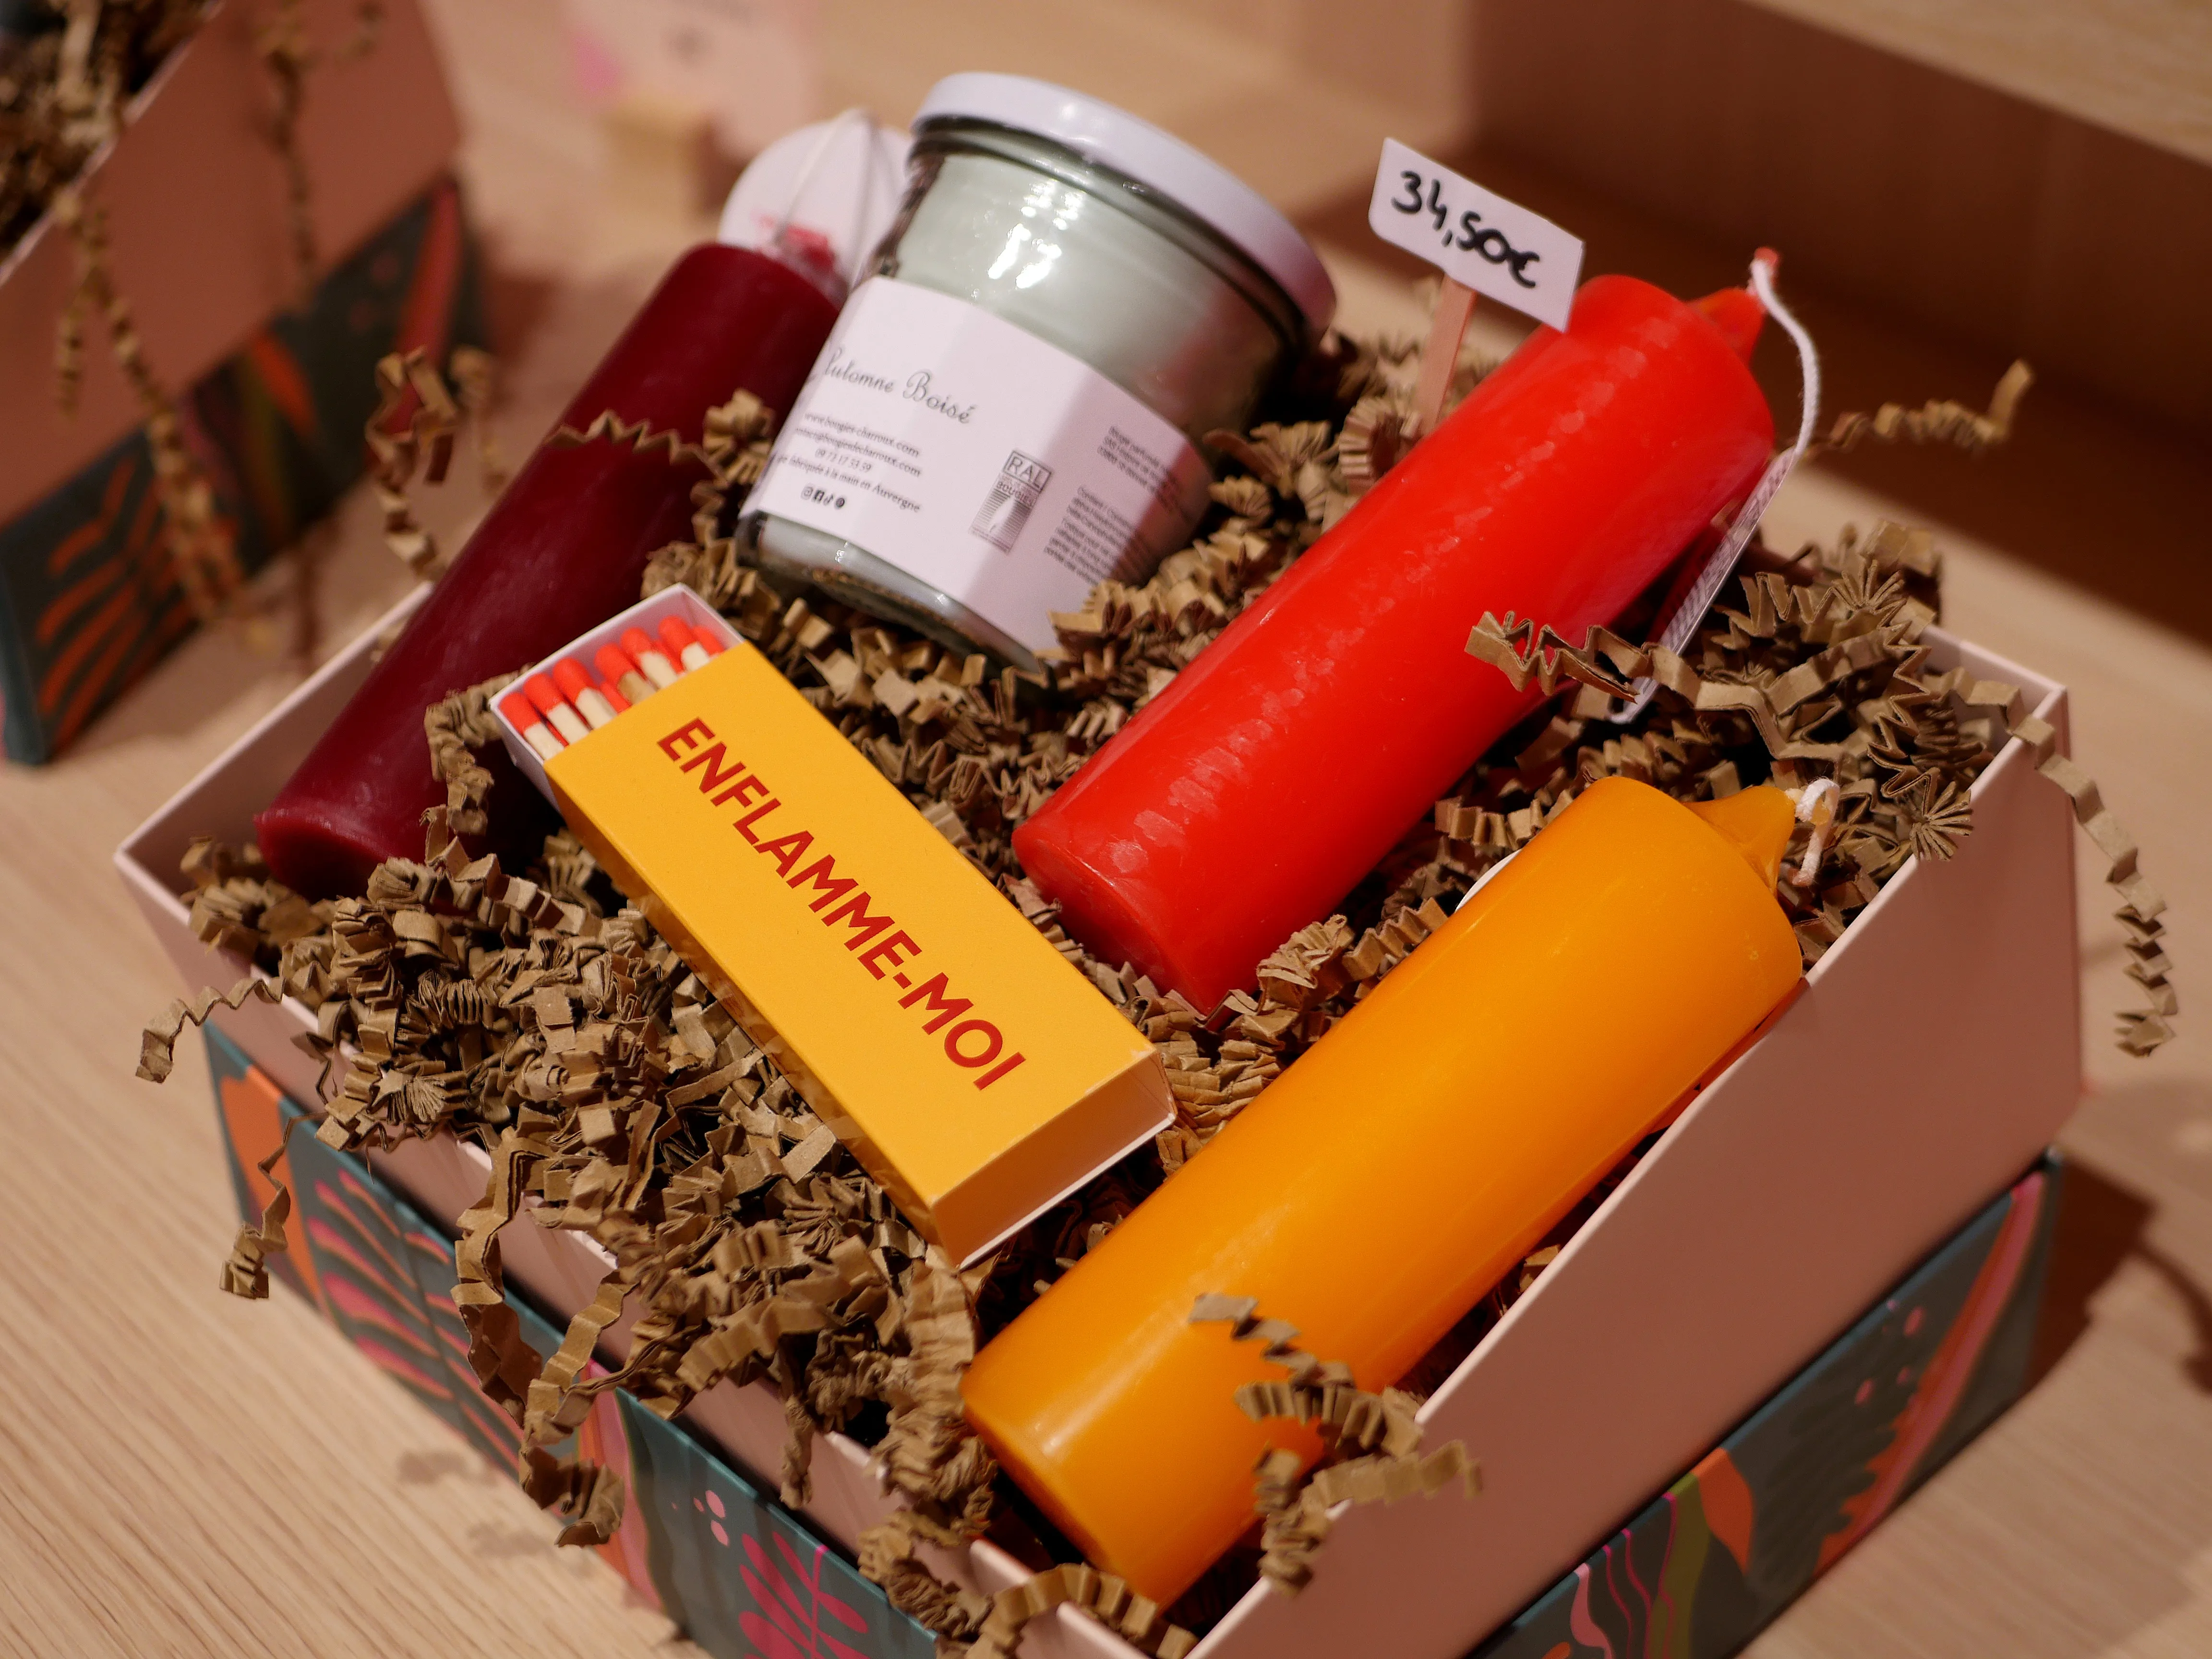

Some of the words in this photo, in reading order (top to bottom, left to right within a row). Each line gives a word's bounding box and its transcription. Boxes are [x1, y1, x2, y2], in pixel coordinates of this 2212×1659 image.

[1392, 170, 1540, 288] 34,50€
[903, 370, 977, 424] Boisé
[839, 473, 859, 488] main
[859, 480, 871, 491] en
[872, 482, 921, 513] Auvergne
[1007, 456, 1042, 489] RAL
[657, 717, 1026, 1090] ENFLAMME-MOI
